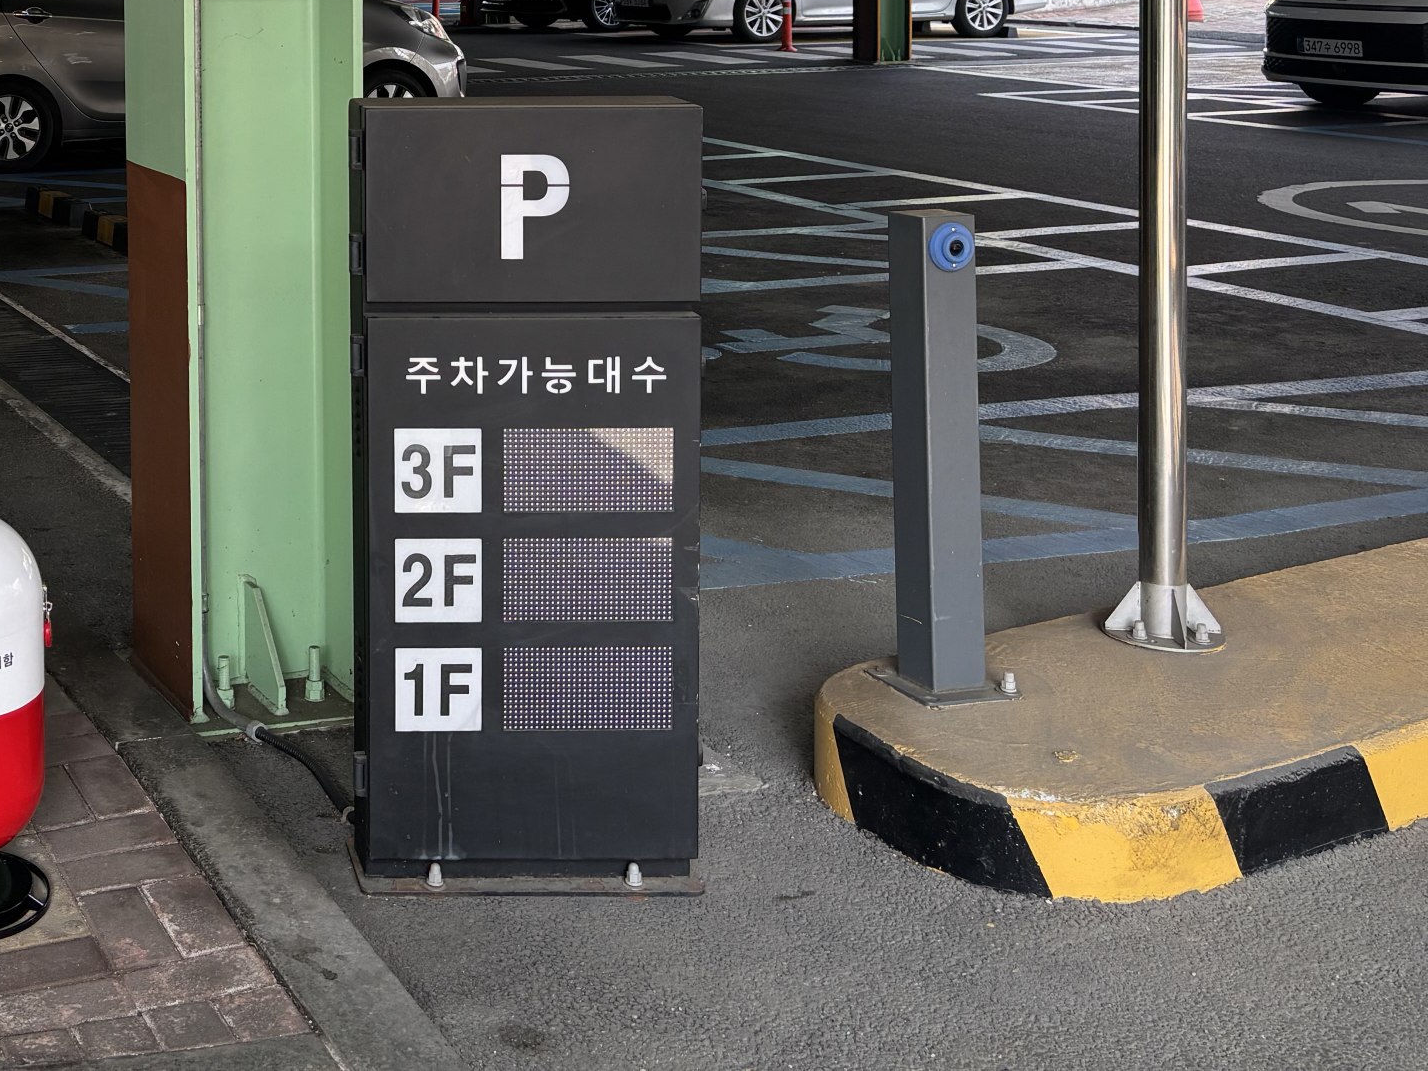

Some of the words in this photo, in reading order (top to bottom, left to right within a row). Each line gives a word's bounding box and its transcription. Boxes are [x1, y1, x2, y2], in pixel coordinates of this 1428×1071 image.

[1334, 42, 1360, 55] 6998
[500, 153, 570, 260] P
[405, 356, 667, 395] 주차가능대수
[400, 443, 476, 499] 3F
[400, 552, 477, 607] 2F
[403, 662, 473, 717] 1F
